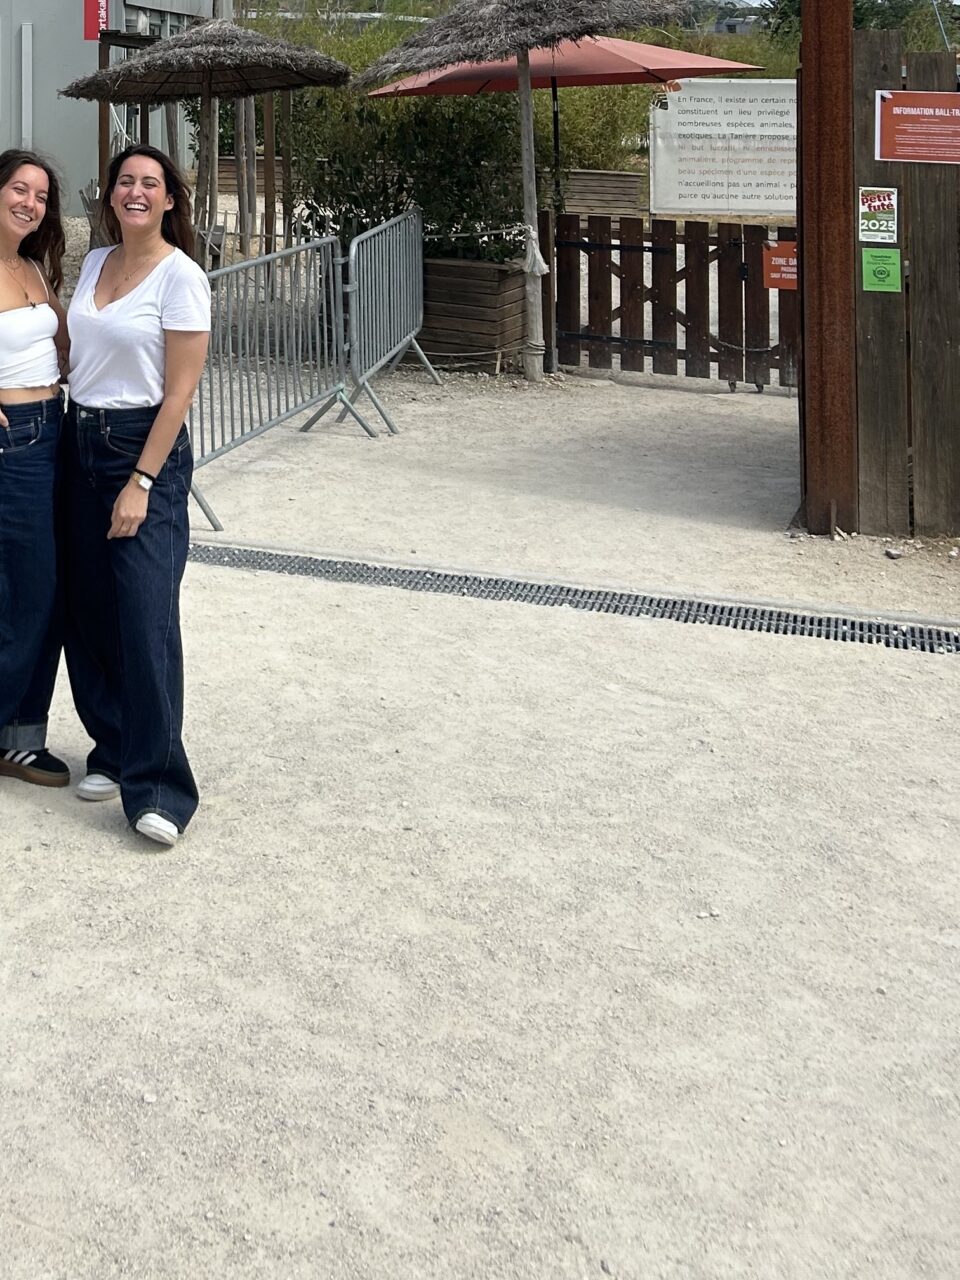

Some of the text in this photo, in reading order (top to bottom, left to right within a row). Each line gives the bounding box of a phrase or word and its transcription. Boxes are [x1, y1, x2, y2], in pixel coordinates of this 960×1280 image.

[690, 96, 716, 104] France,
[757, 109, 790, 117] privilégié
[892, 107, 934, 115] INFORMATION
[727, 121, 755, 129] espèces
[760, 121, 795, 129] animales,
[730, 132, 757, 140] Tanière
[698, 168, 733, 176] spécimen
[760, 169, 785, 177] espèce
[764, 193, 794, 201] solution
[861, 193, 892, 206] petit
[867, 202, 894, 212] futé
[861, 220, 895, 231] 2025
[771, 257, 788, 265] ZONE
